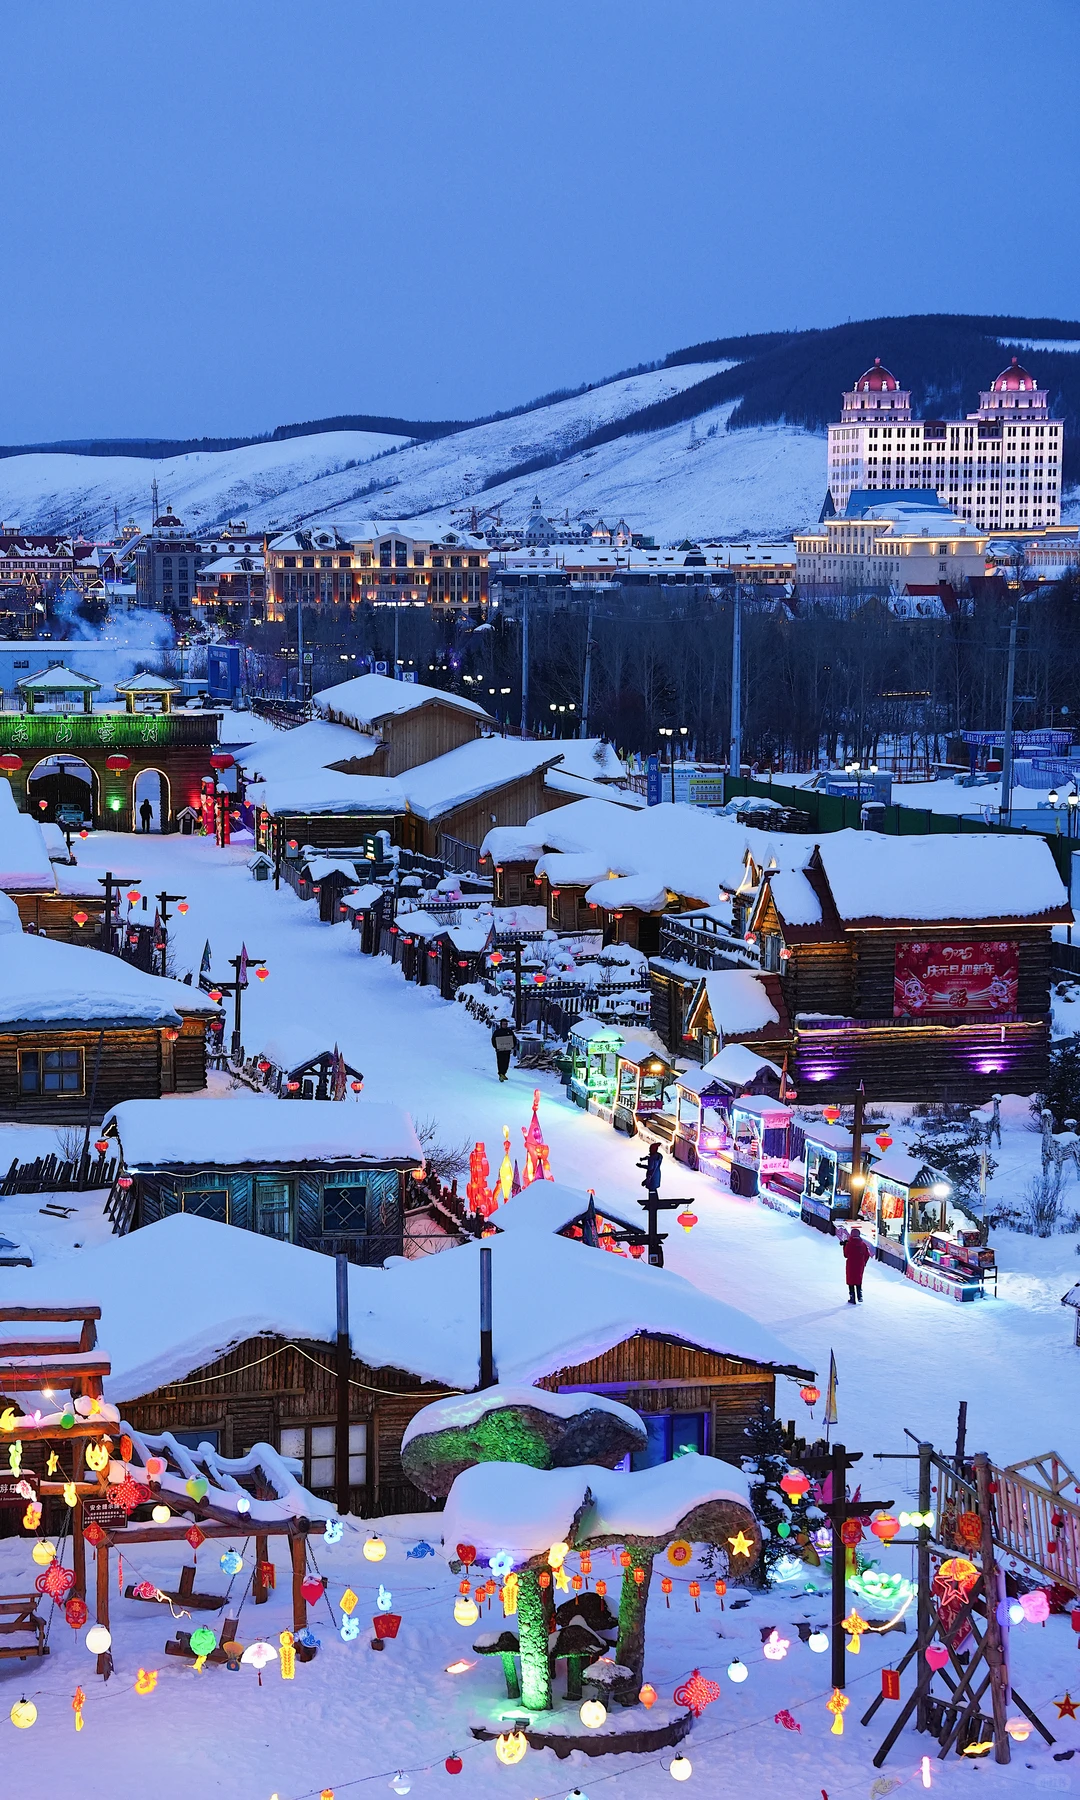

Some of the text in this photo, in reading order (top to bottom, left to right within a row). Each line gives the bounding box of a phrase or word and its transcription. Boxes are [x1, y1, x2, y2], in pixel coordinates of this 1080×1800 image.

[922, 961, 996, 979] 庆元旦迎新年
[88, 1528, 99, 1540] 福
[190, 1531, 199, 1543] 福
